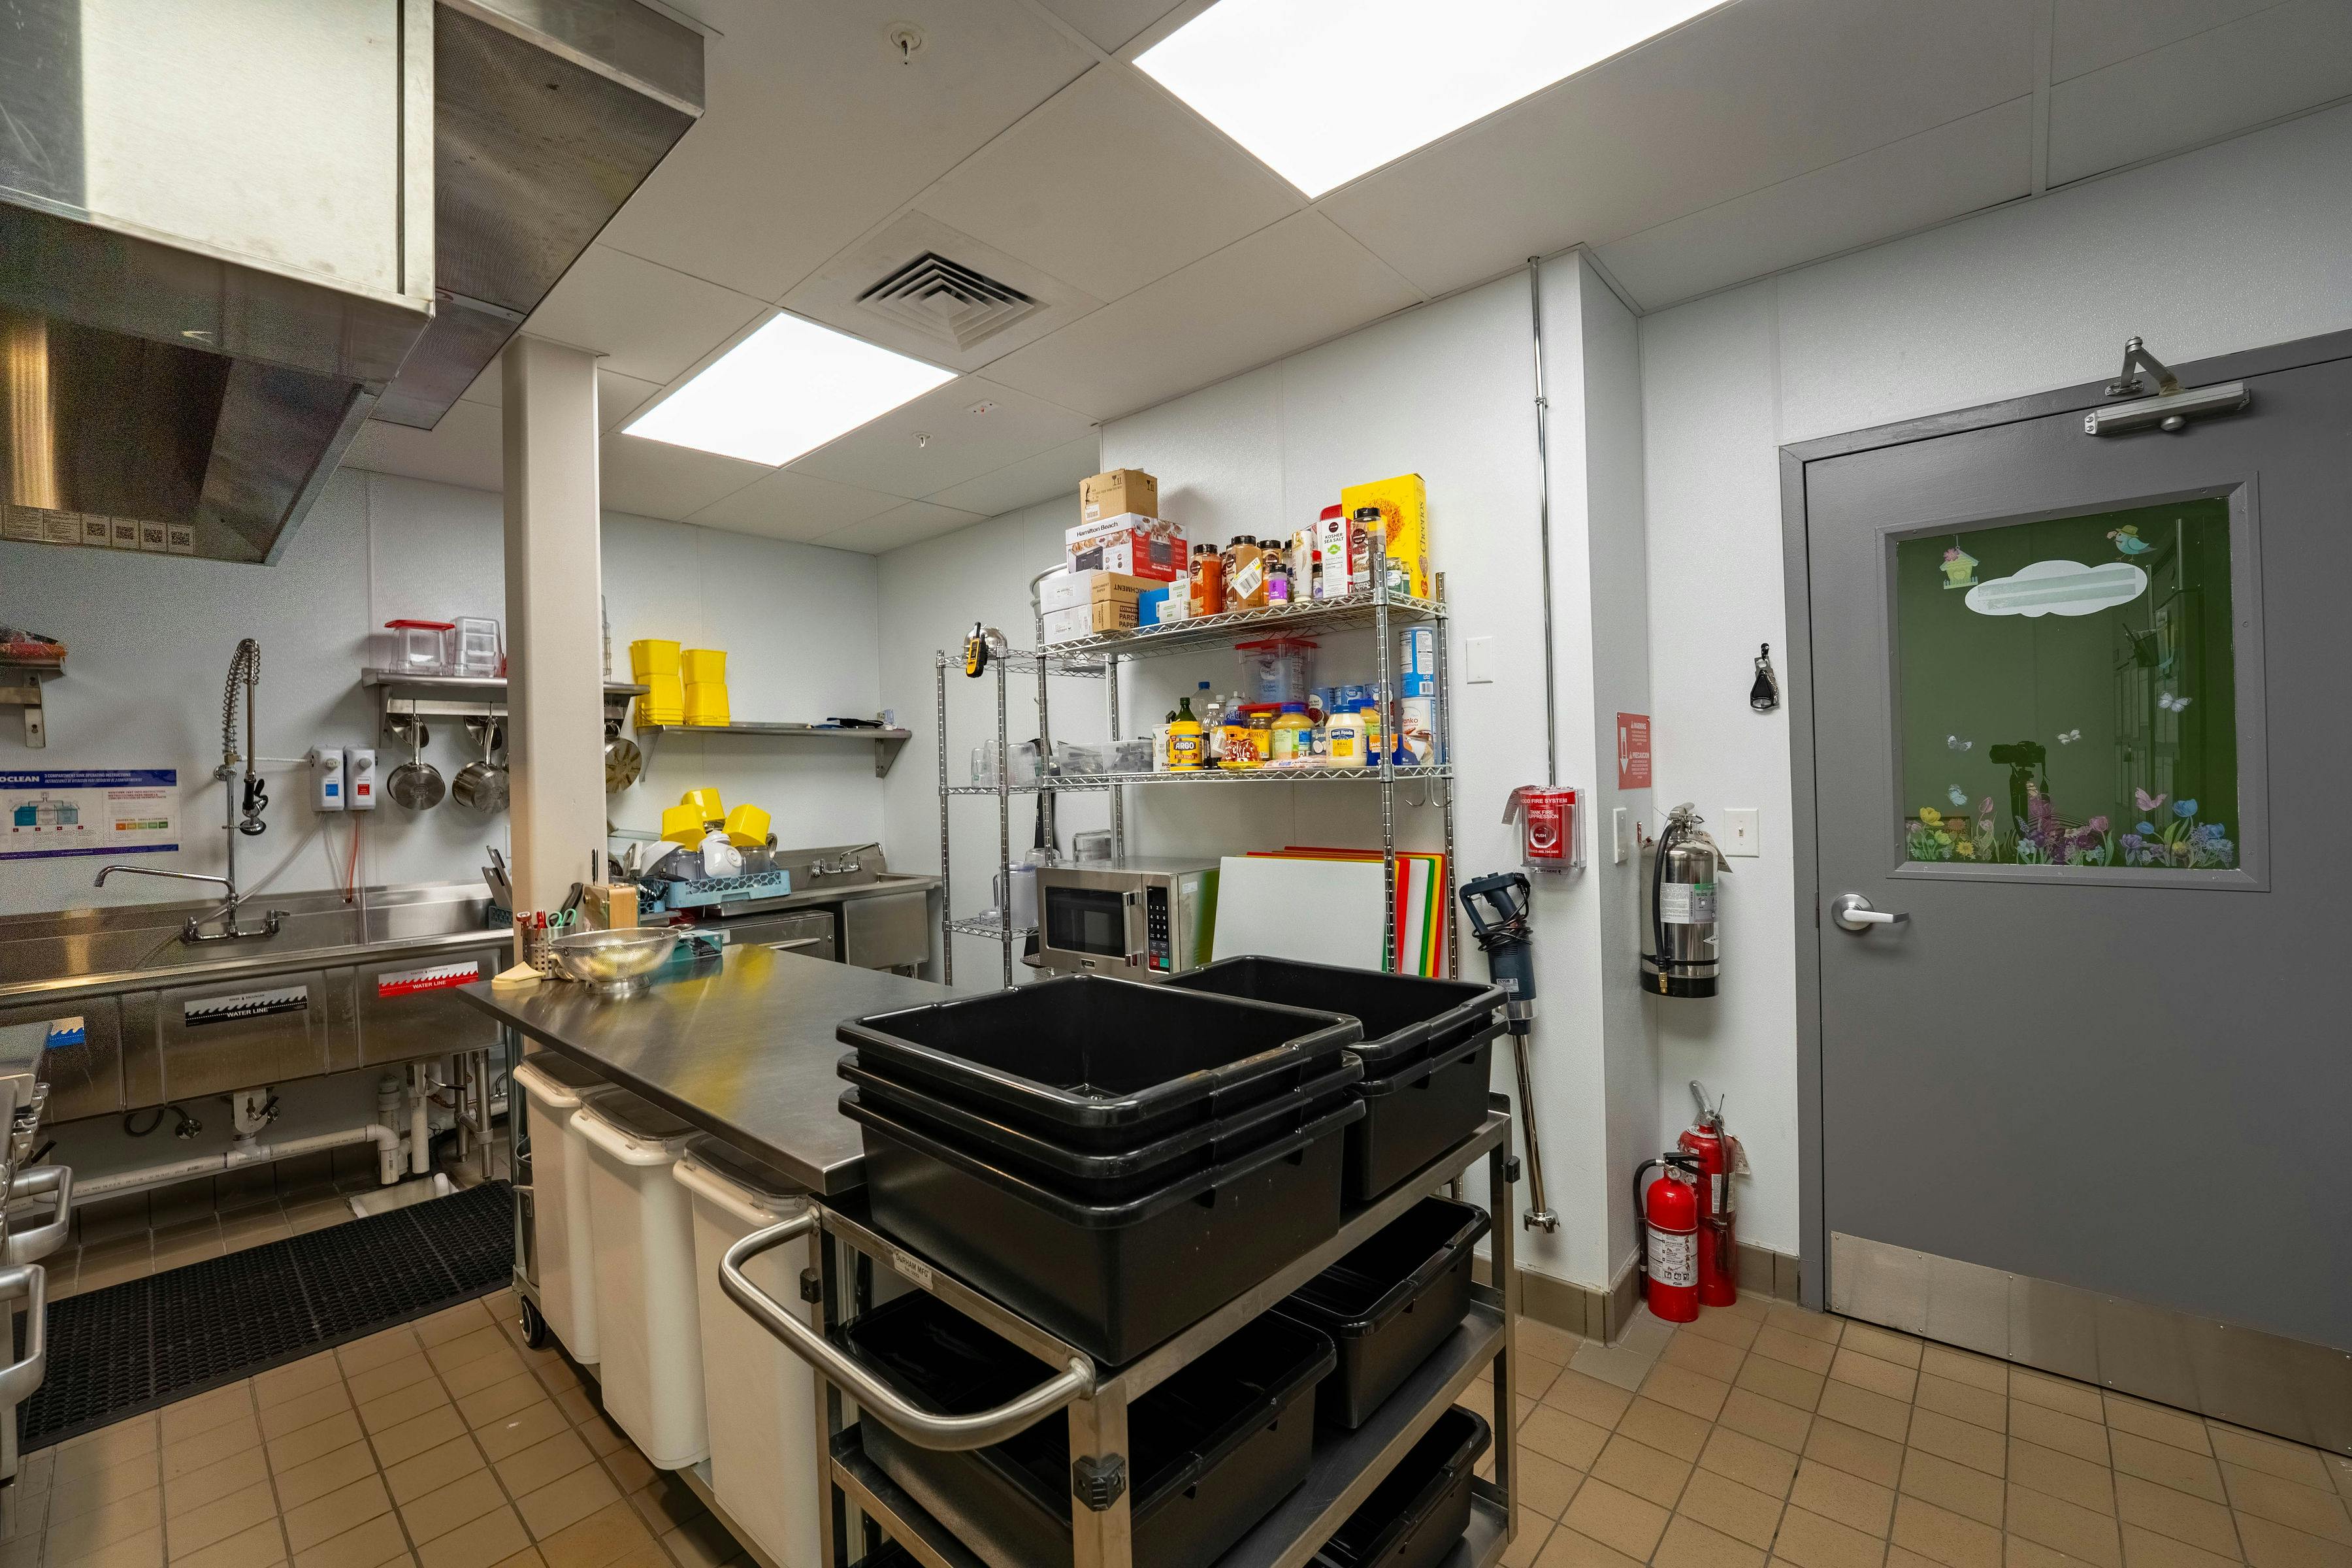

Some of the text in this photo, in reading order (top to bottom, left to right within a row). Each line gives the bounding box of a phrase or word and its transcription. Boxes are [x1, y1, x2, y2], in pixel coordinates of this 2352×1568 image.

[1077, 521, 1119, 537] Hamilton Beach
[227, 1009, 252, 1018] WATER
[896, 1252, 928, 1277] DURHAM MFG
